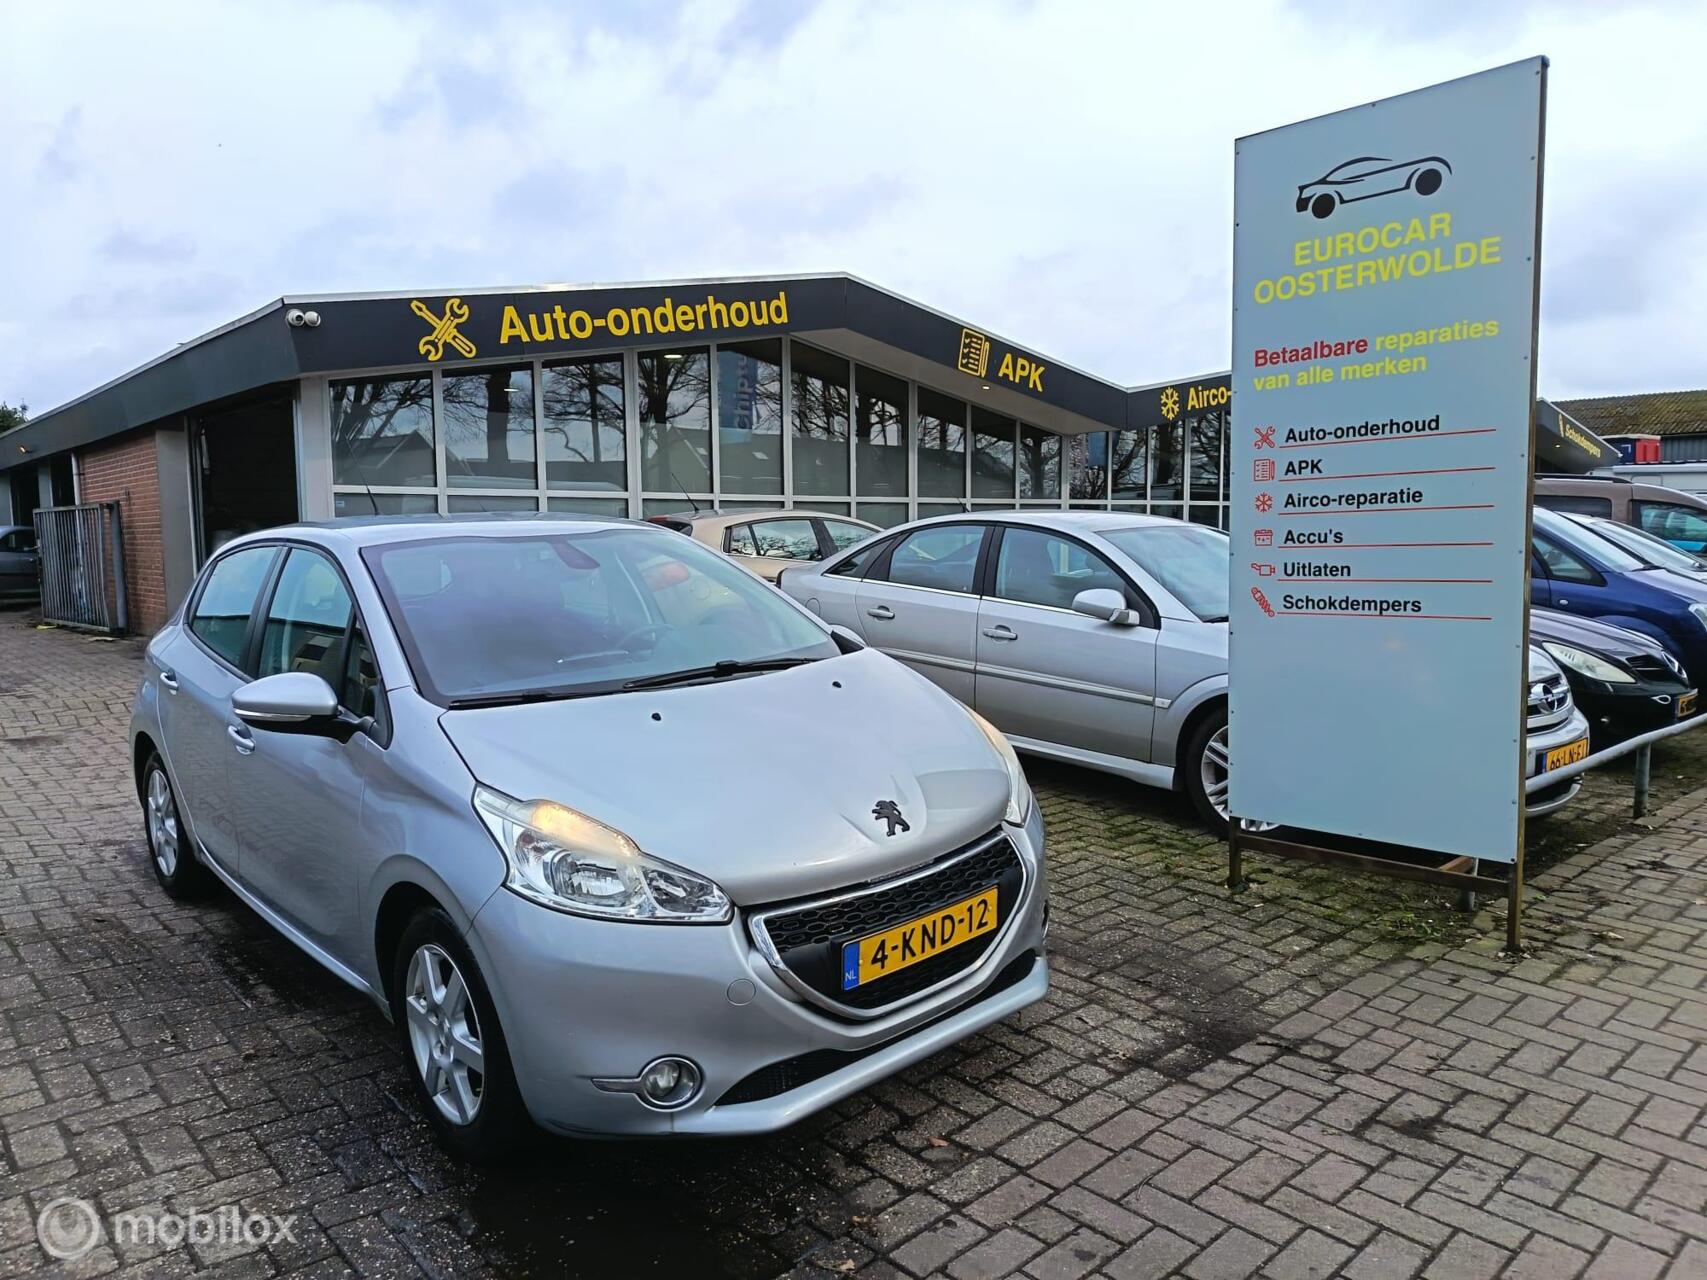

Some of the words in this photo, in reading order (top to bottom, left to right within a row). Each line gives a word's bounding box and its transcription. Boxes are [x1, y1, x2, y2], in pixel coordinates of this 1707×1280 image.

[1294, 212, 1451, 266] EUROCAR
[1254, 236, 1501, 304] OOSTERWOLDE
[499, 291, 788, 344] Auto-onderhoud
[1254, 338, 1368, 367] Betaalbare
[1375, 319, 1499, 353] reparaties
[998, 353, 1045, 392] APK
[1253, 372, 1290, 391] van
[1296, 365, 1333, 386] alle
[1341, 356, 1427, 381] merken
[1285, 415, 1440, 443] Auto-onderhoud
[1284, 459, 1323, 476] APK
[1284, 488, 1423, 509] Airco-reparatie
[1284, 529, 1344, 545] Accu's
[1283, 562, 1351, 577] Uitlaten
[1283, 595, 1422, 615] Schokdempers
[870, 898, 989, 970] 4-KND-12
[845, 969, 857, 981] NL
